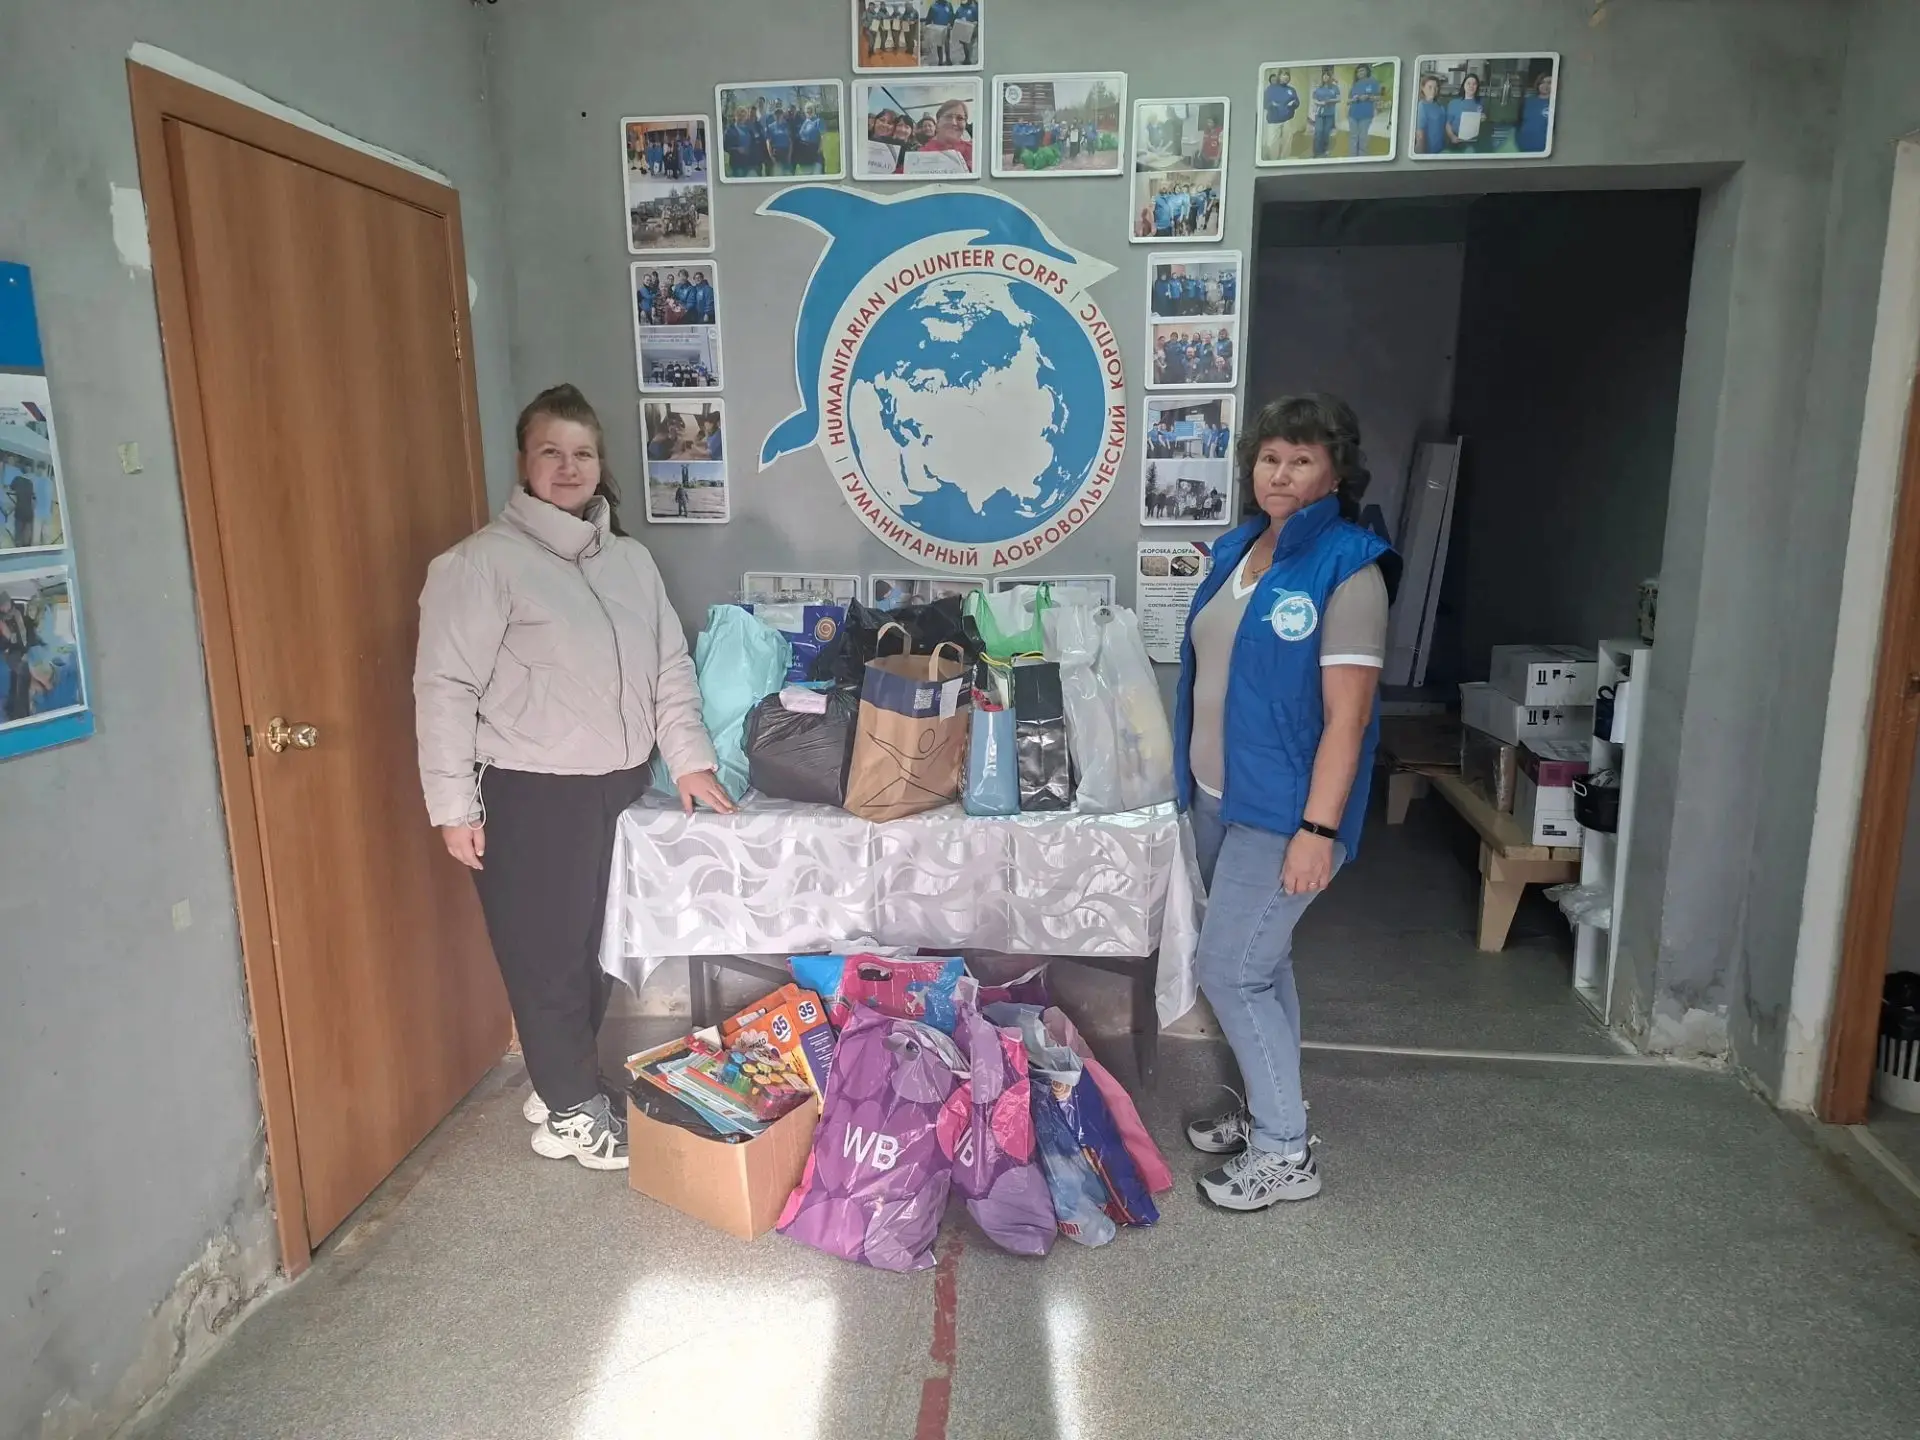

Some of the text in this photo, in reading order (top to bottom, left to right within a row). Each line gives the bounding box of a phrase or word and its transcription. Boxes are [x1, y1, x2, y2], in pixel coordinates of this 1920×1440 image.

[827, 249, 1068, 445] HUMANITARIAN VOLUNTEER CORPS
[842, 303, 1126, 567] ГУМАНИТАРНЫЙ ДОБРОВОЛЬЧЕСКИЙ КОРПУС
[772, 1015, 788, 1036] 35
[798, 1002, 815, 1018] 35
[843, 1122, 899, 1170] WB
